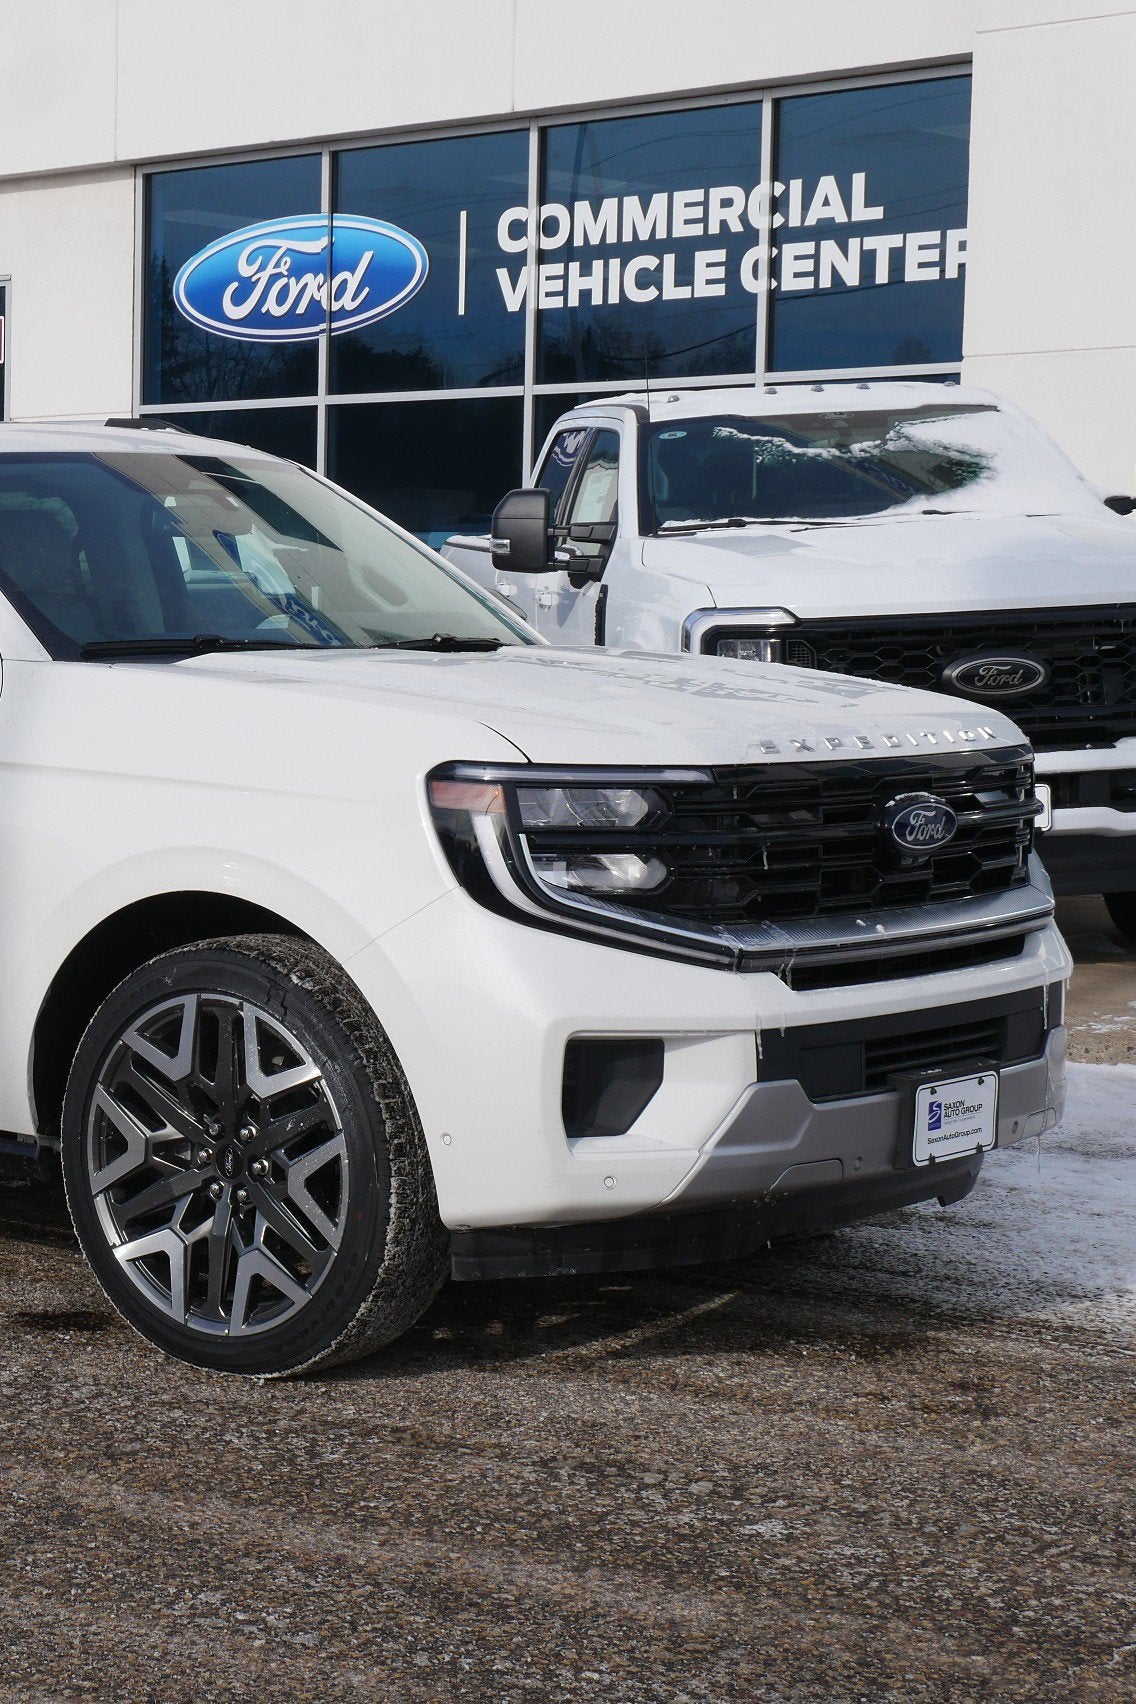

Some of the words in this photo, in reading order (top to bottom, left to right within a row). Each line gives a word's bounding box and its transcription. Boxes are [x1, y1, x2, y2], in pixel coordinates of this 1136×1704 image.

[497, 172, 884, 253] COMMERCIAL
[222, 235, 375, 321] Ford
[496, 248, 727, 312] VEHICLE
[974, 665, 1024, 687] Ford
[760, 726, 997, 755] EXPEDITION
[905, 810, 947, 842] Ford
[943, 1100, 965, 1111] SAXON
[943, 1108, 960, 1119] AUTO
[960, 1103, 983, 1115] GROUP
[927, 1127, 983, 1145] SaxonAutoGroup.com
